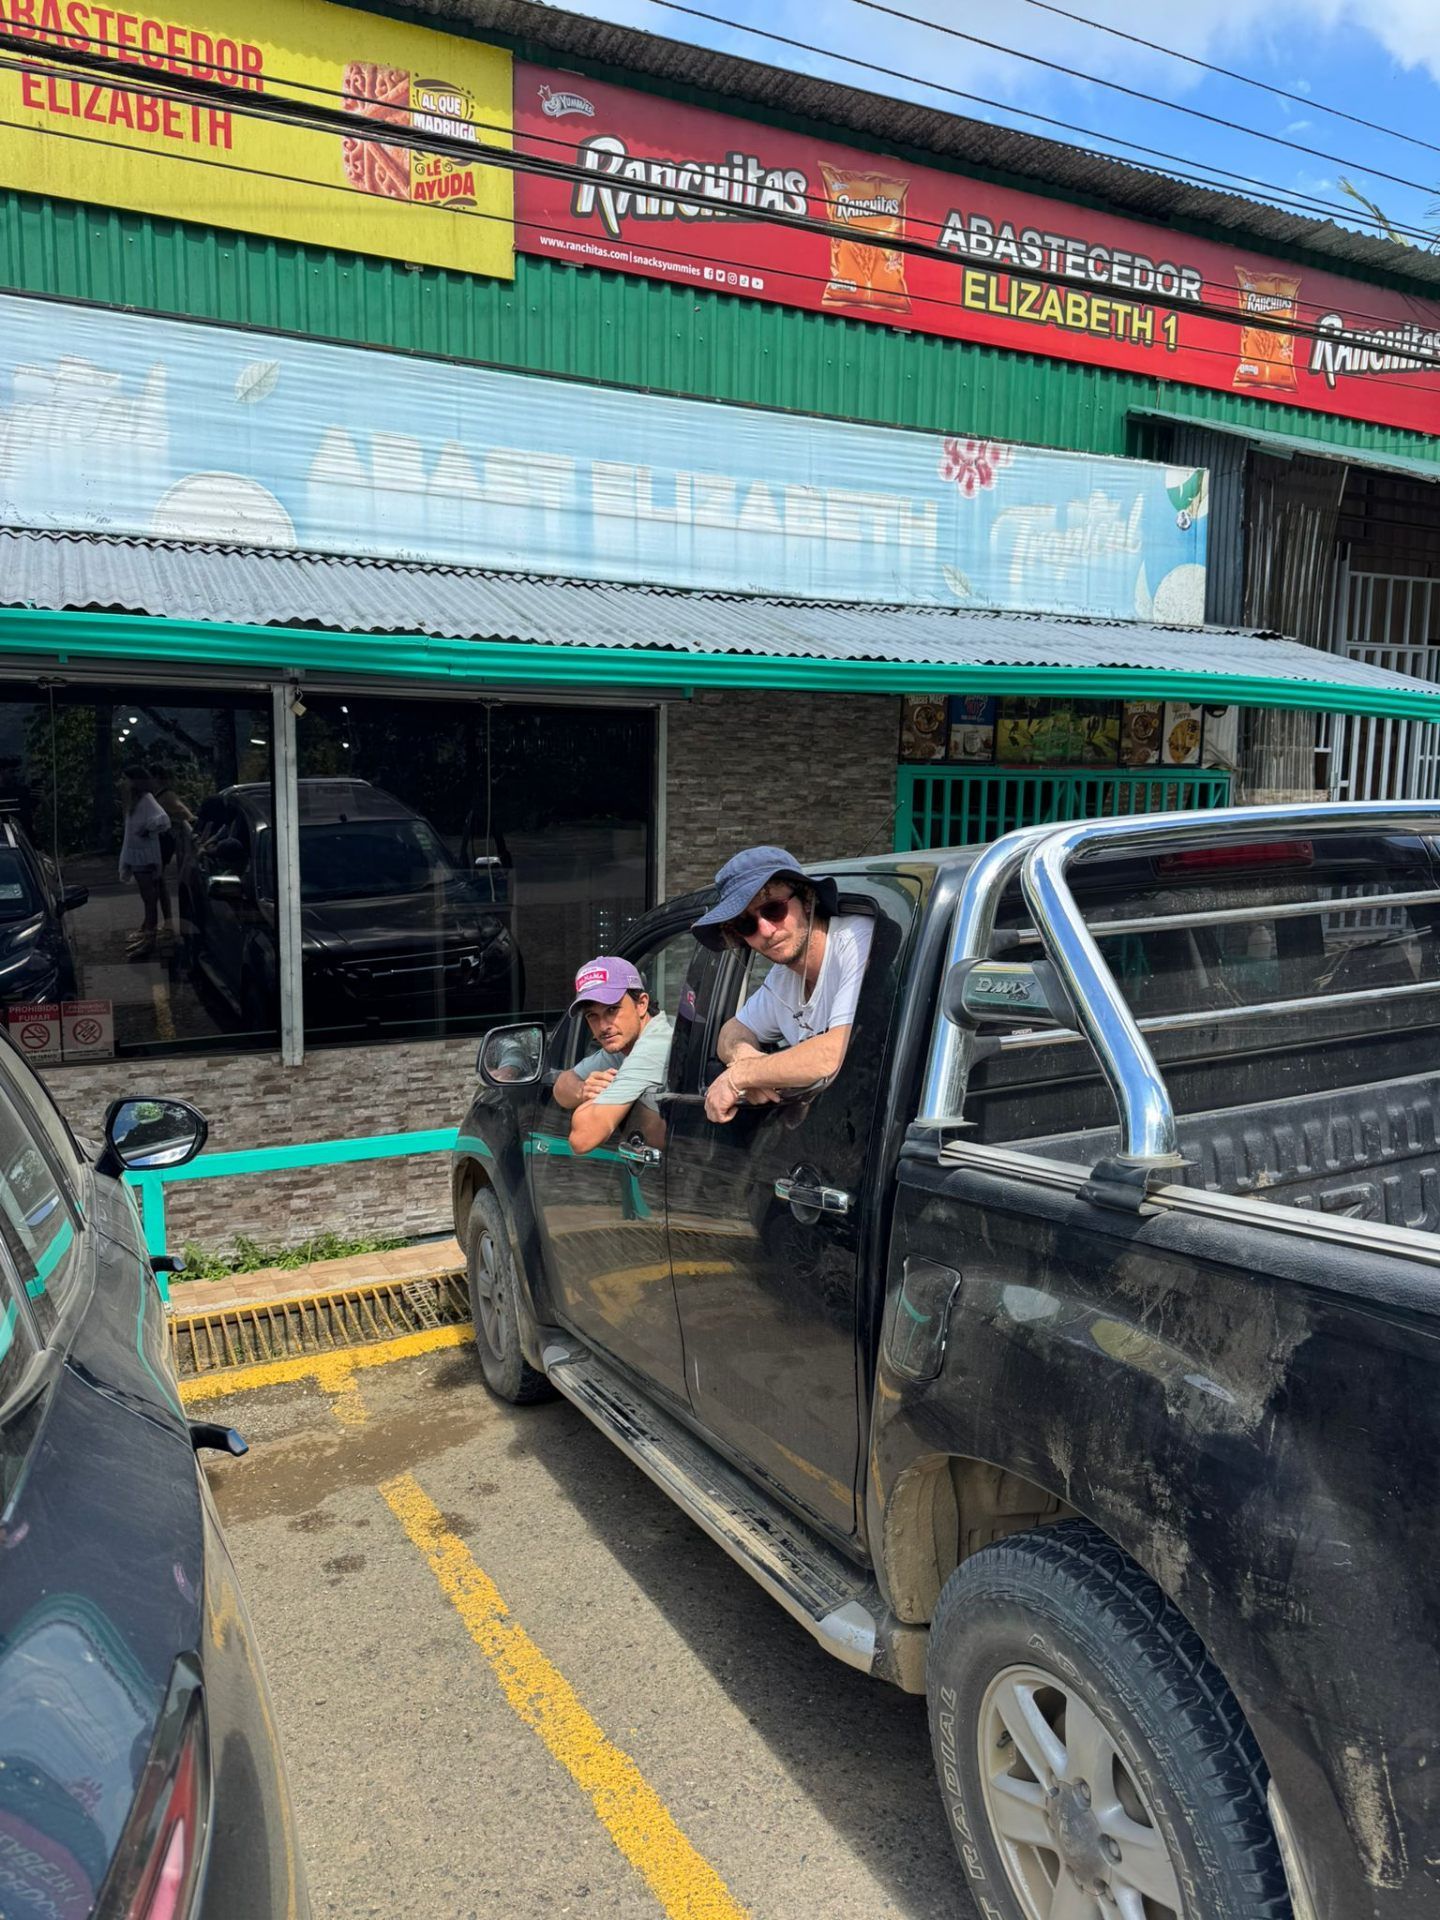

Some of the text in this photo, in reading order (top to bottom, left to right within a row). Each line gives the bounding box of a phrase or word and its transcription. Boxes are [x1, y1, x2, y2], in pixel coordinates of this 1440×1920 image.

[422, 93, 461, 116] AL QUE
[414, 171, 475, 201] AYUDA
[426, 159, 442, 176] LE
[940, 212, 1201, 301] ABASTECEDOR
[964, 269, 1177, 350] ELIZABETH 1
[940, 1687, 986, 1880] RADIAL
